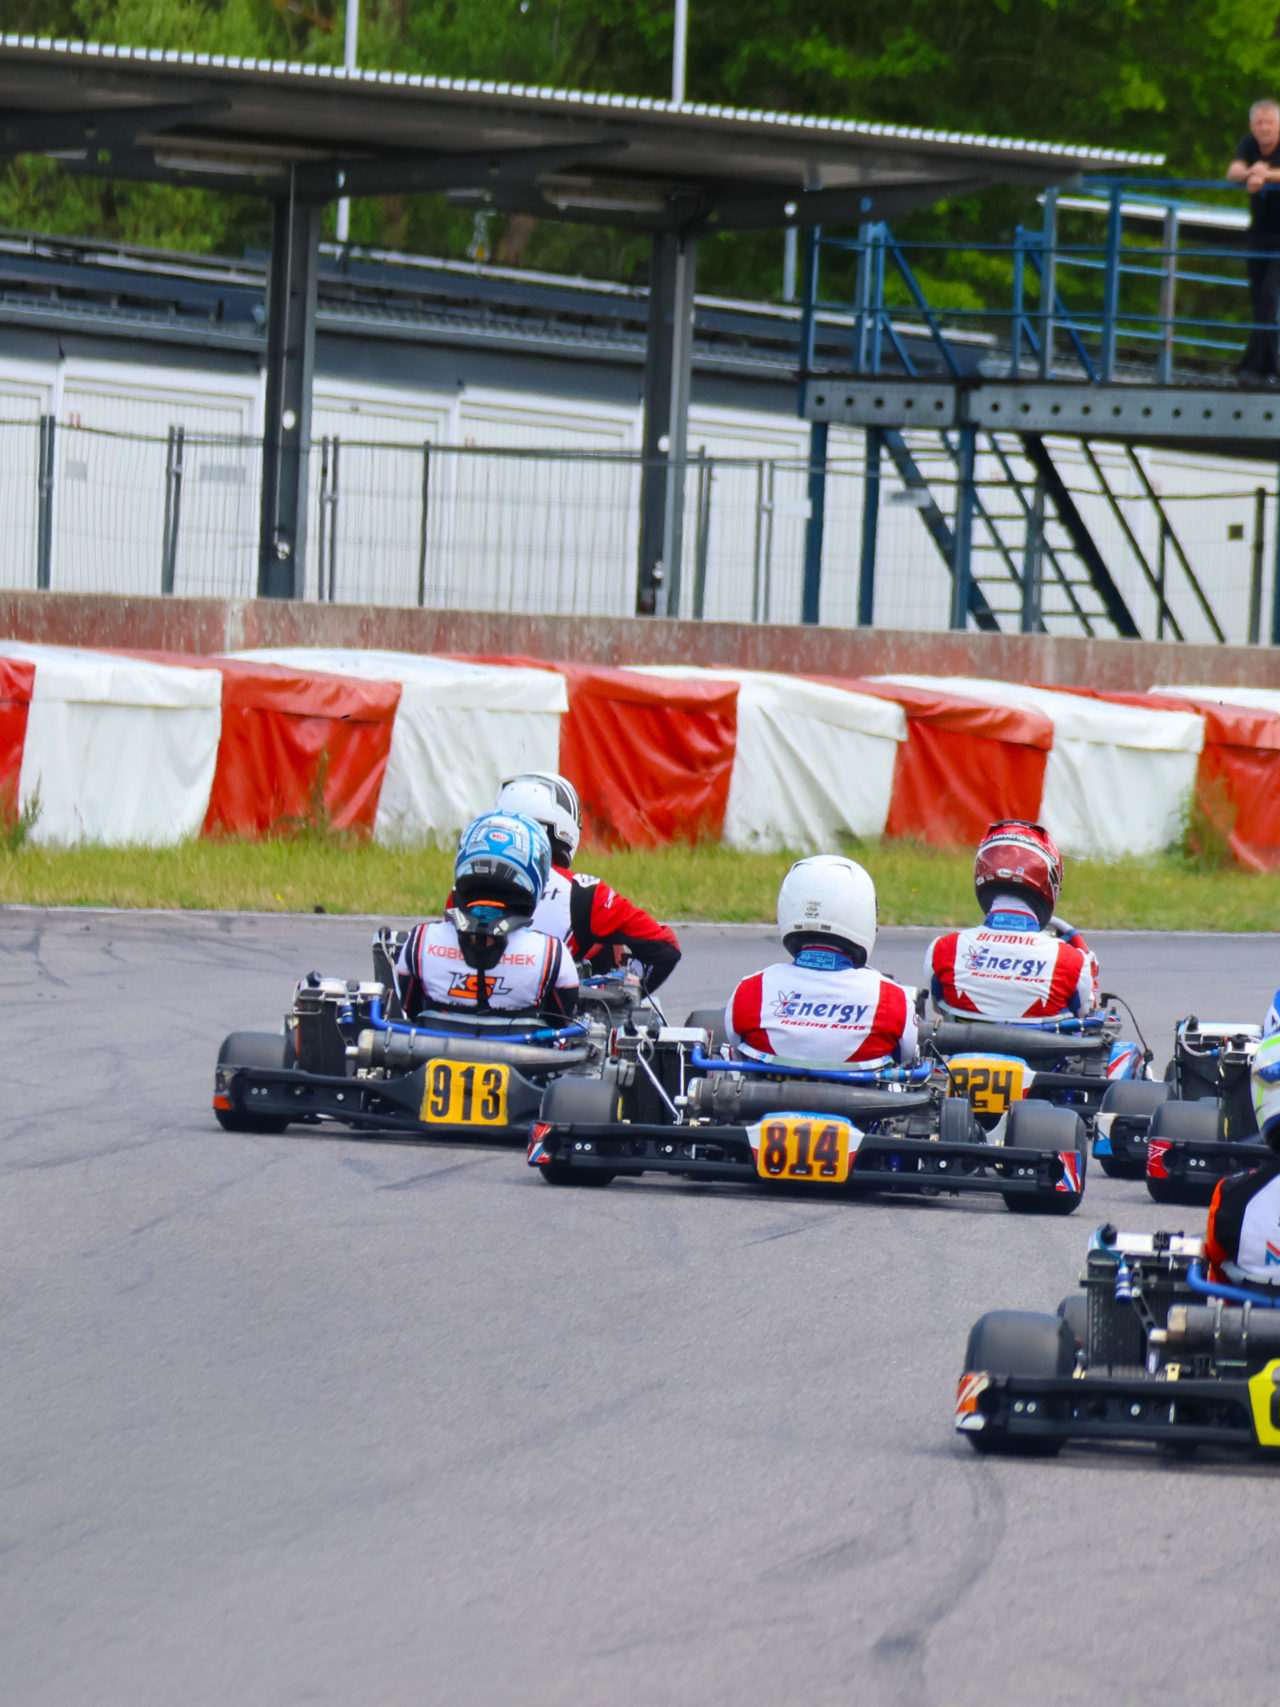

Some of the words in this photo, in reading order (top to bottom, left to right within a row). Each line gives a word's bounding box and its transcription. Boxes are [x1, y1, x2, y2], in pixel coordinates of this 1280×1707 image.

[971, 948, 1046, 976] Energy
[780, 993, 868, 1023] Energy
[430, 1064, 503, 1121] 913
[949, 1067, 1013, 1111] 824
[763, 1121, 840, 1177] 814
